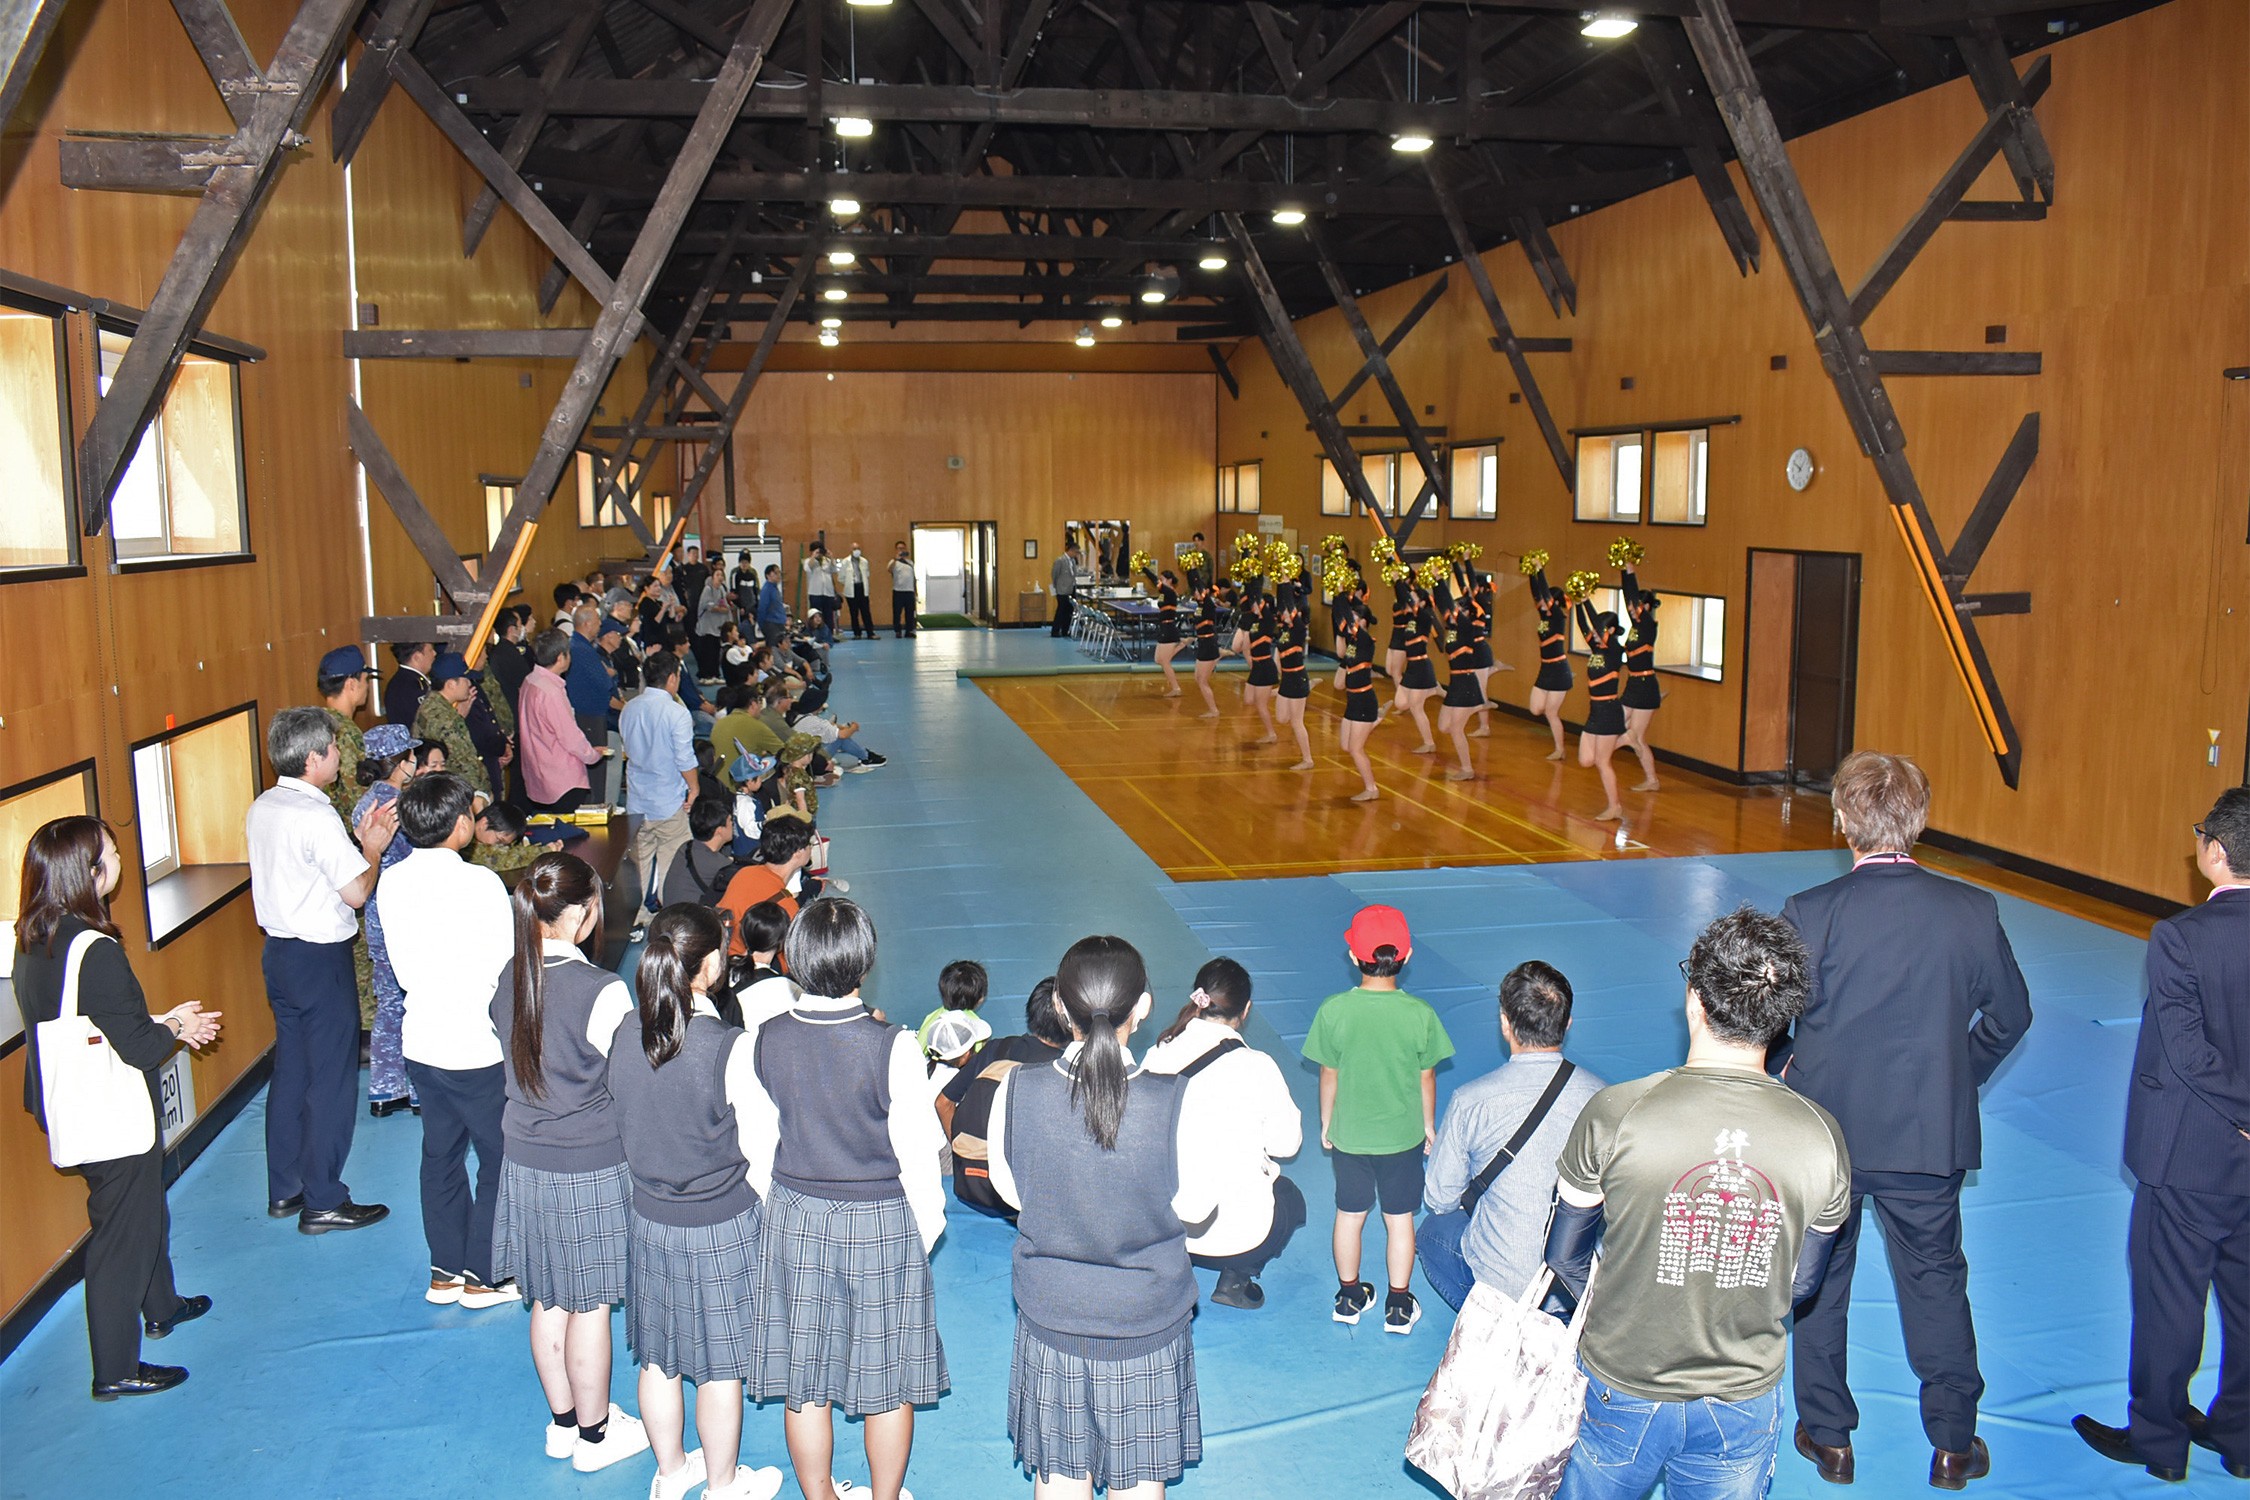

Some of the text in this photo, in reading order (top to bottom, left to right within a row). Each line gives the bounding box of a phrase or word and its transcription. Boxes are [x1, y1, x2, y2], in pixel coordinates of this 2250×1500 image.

[162, 1073, 176, 1103] 20
[167, 1106, 177, 1129] m
[1713, 1128, 1751, 1158] 絆
